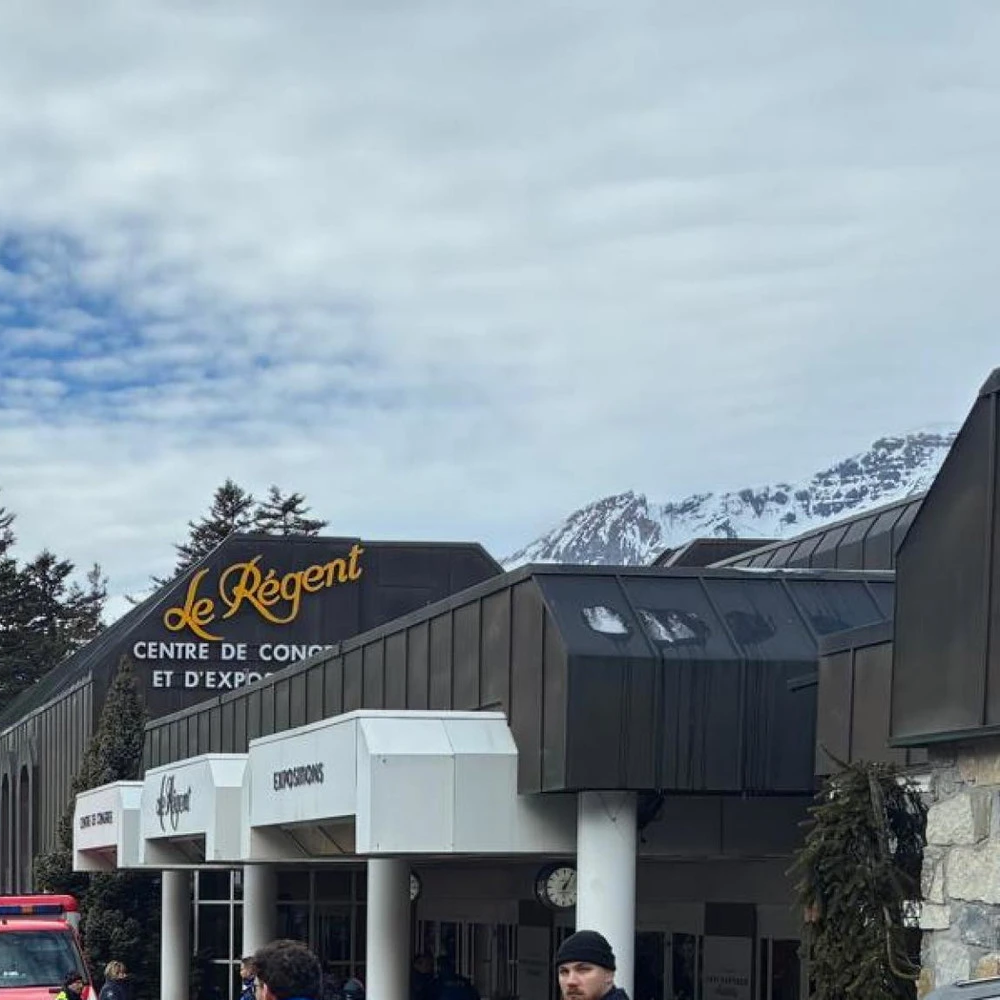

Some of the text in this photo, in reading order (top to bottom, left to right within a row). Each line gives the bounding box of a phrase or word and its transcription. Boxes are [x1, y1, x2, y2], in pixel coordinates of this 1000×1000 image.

[163, 543, 364, 641] Le Régent
[133, 641, 210, 660] CENTRE
[221, 642, 247, 661] DE
[153, 669, 274, 689] ET D'EXPO
